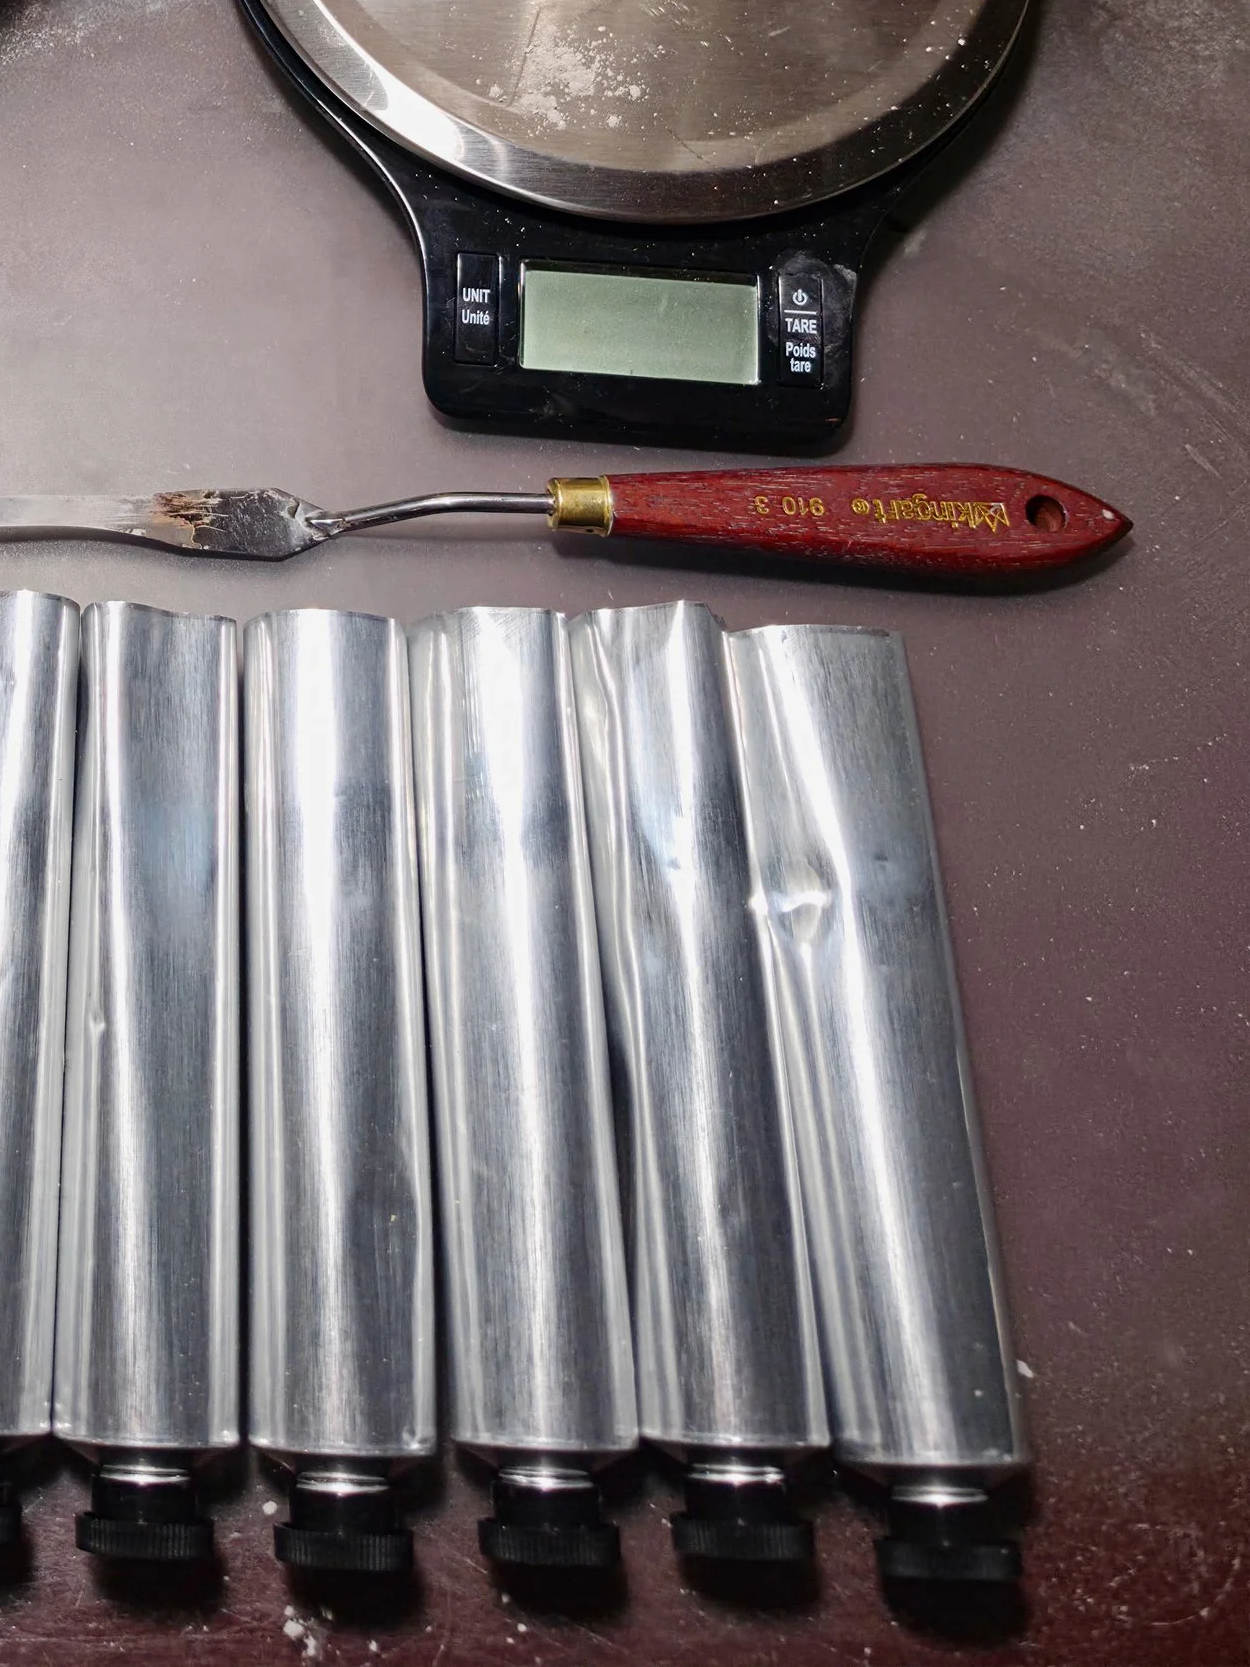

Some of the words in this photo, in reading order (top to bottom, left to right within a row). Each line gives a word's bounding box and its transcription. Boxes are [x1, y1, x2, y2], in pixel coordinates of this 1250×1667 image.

[462, 287, 491, 304] UNIT
[461, 308, 491, 326] Unité
[784, 317, 818, 335] TARE
[785, 341, 817, 360] Poids
[789, 358, 812, 373] tare
[753, 495, 770, 515] 3
[782, 496, 825, 517] 910
